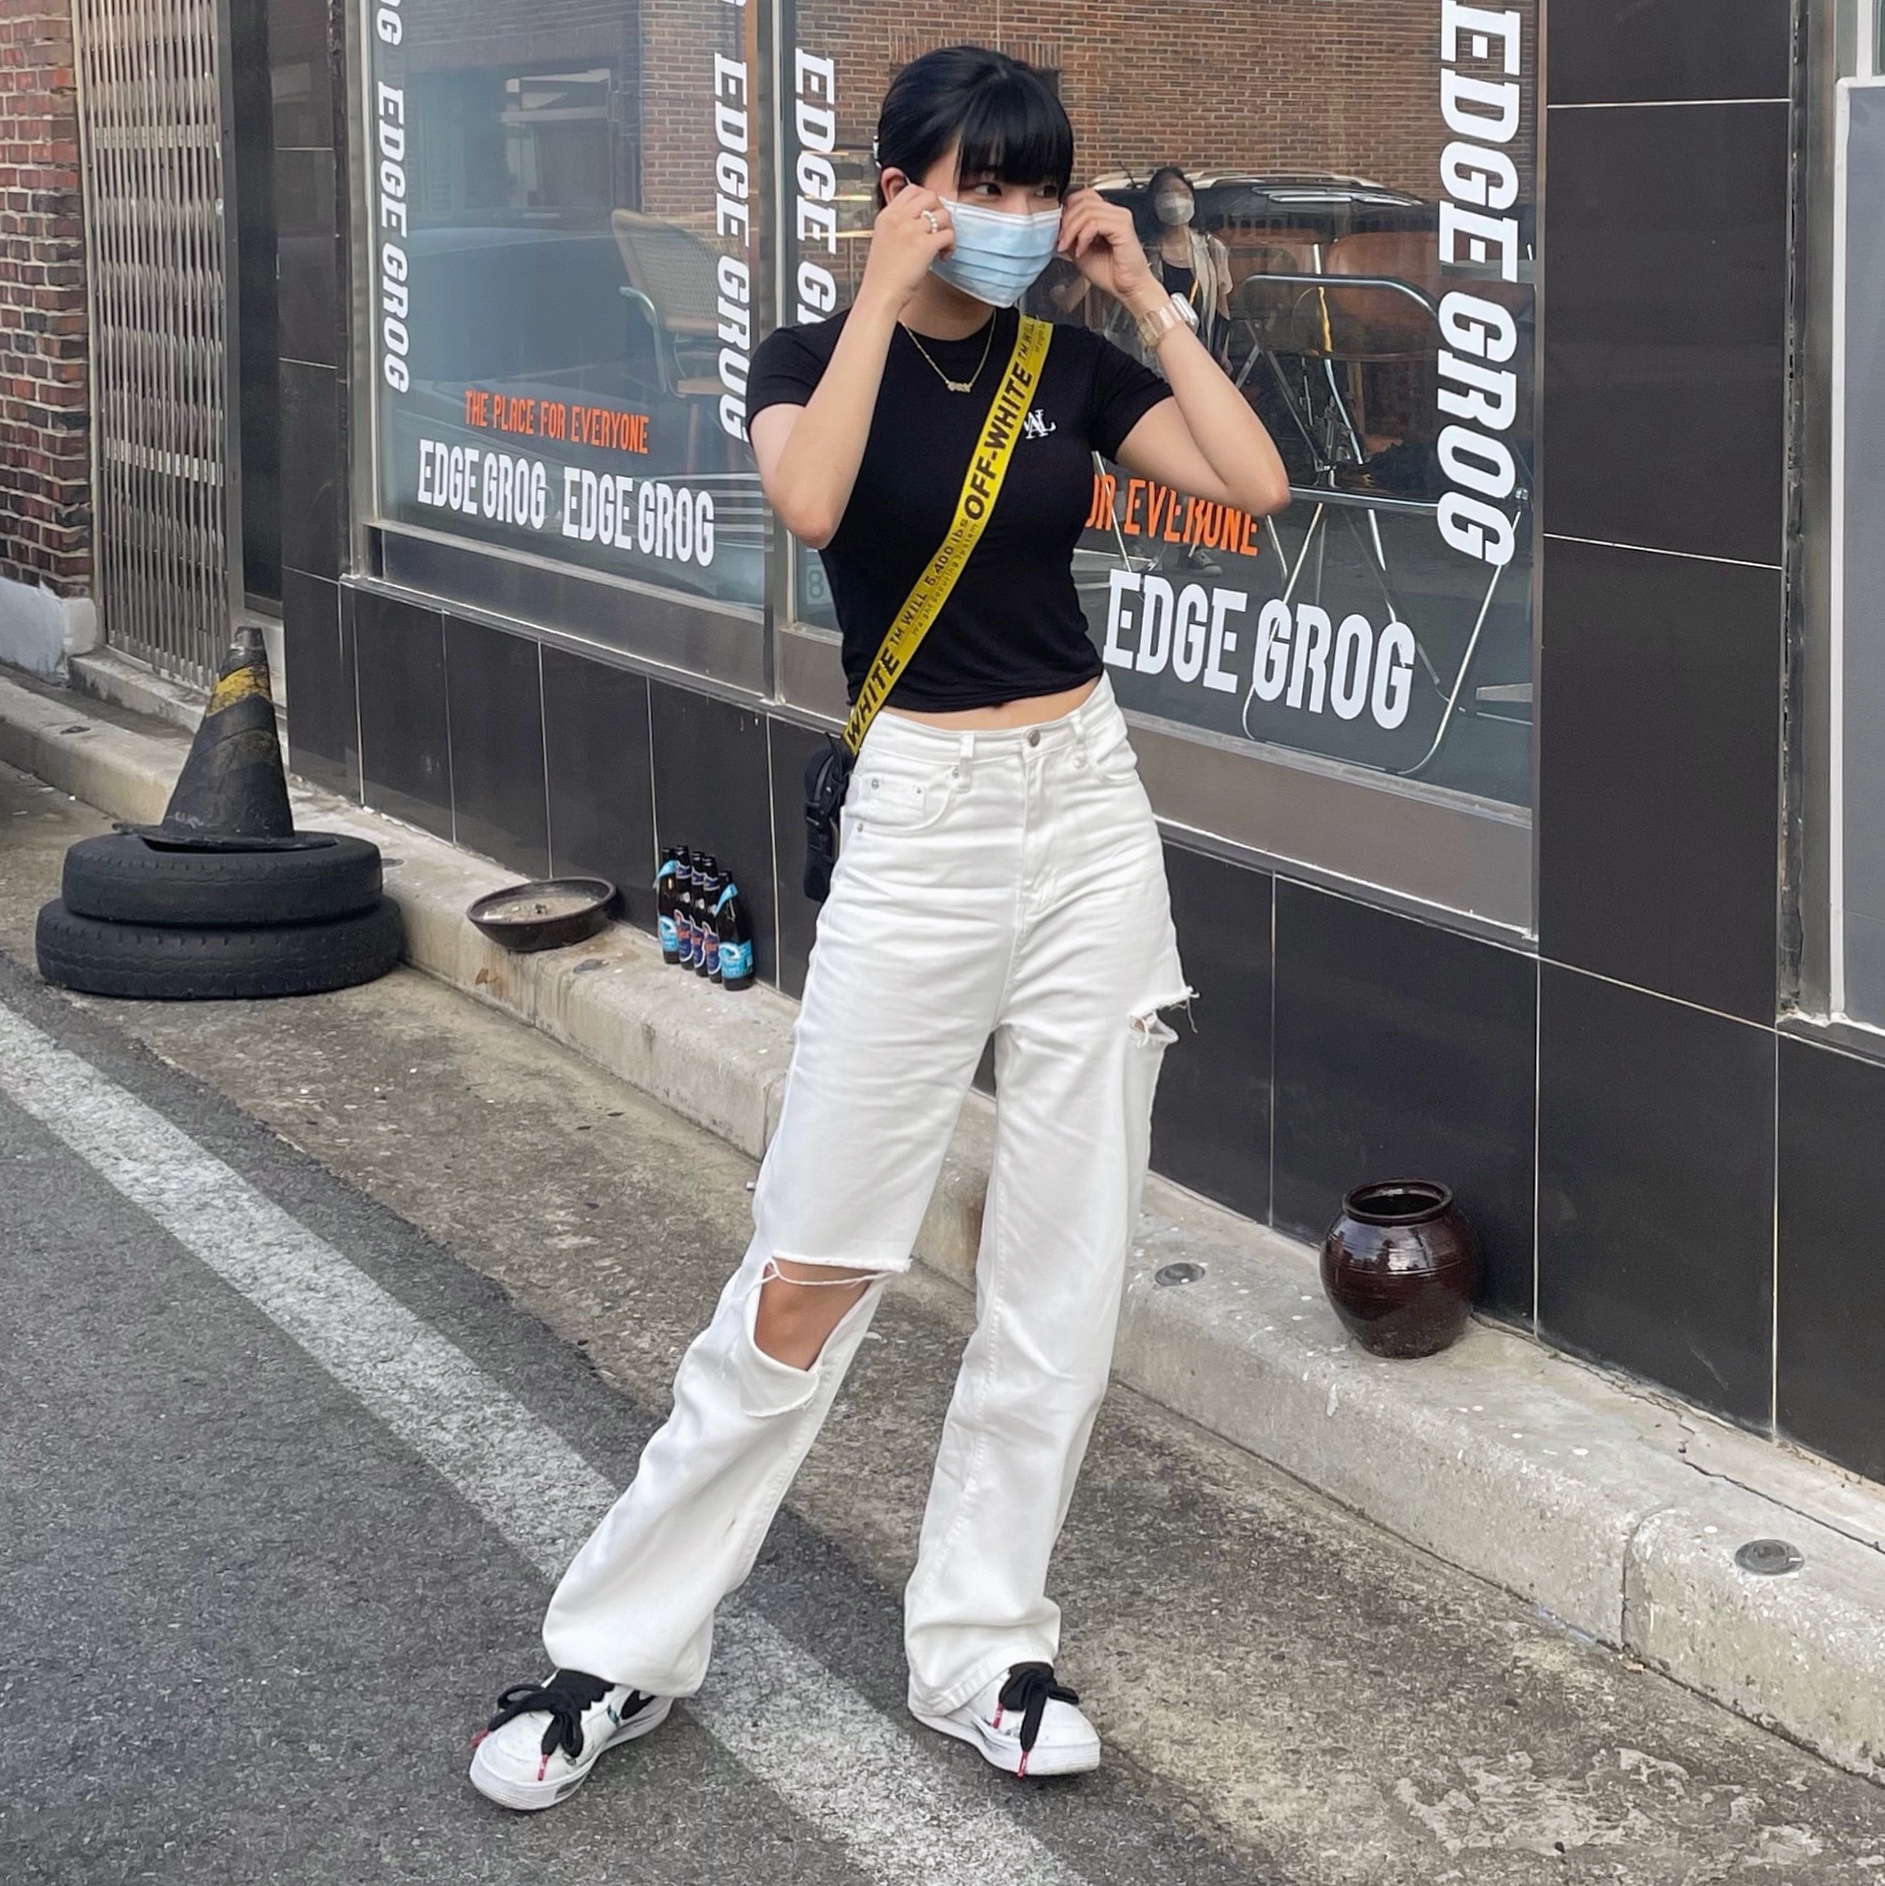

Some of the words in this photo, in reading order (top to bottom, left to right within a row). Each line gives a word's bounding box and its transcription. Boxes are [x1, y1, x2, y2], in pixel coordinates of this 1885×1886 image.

[378, 81, 407, 238] EDGE
[714, 52, 749, 248] EDGE
[795, 47, 836, 255] EDGE
[1439, 0, 1520, 283] EDGE
[382, 242, 410, 393] GROG
[464, 390, 489, 427] THE
[493, 394, 535, 434] PLACE
[540, 401, 565, 440] FOR
[571, 406, 651, 454] EVERYONE
[964, 361, 1033, 520] OFF-WHITE
[1436, 291, 1518, 566] GROG
[417, 439, 479, 515] EDGE
[482, 452, 546, 529] GROG
[562, 466, 633, 550] EDGE
[638, 481, 715, 567] GROG
[1102, 568, 1247, 694] EDGE
[1253, 598, 1416, 730] GROG
